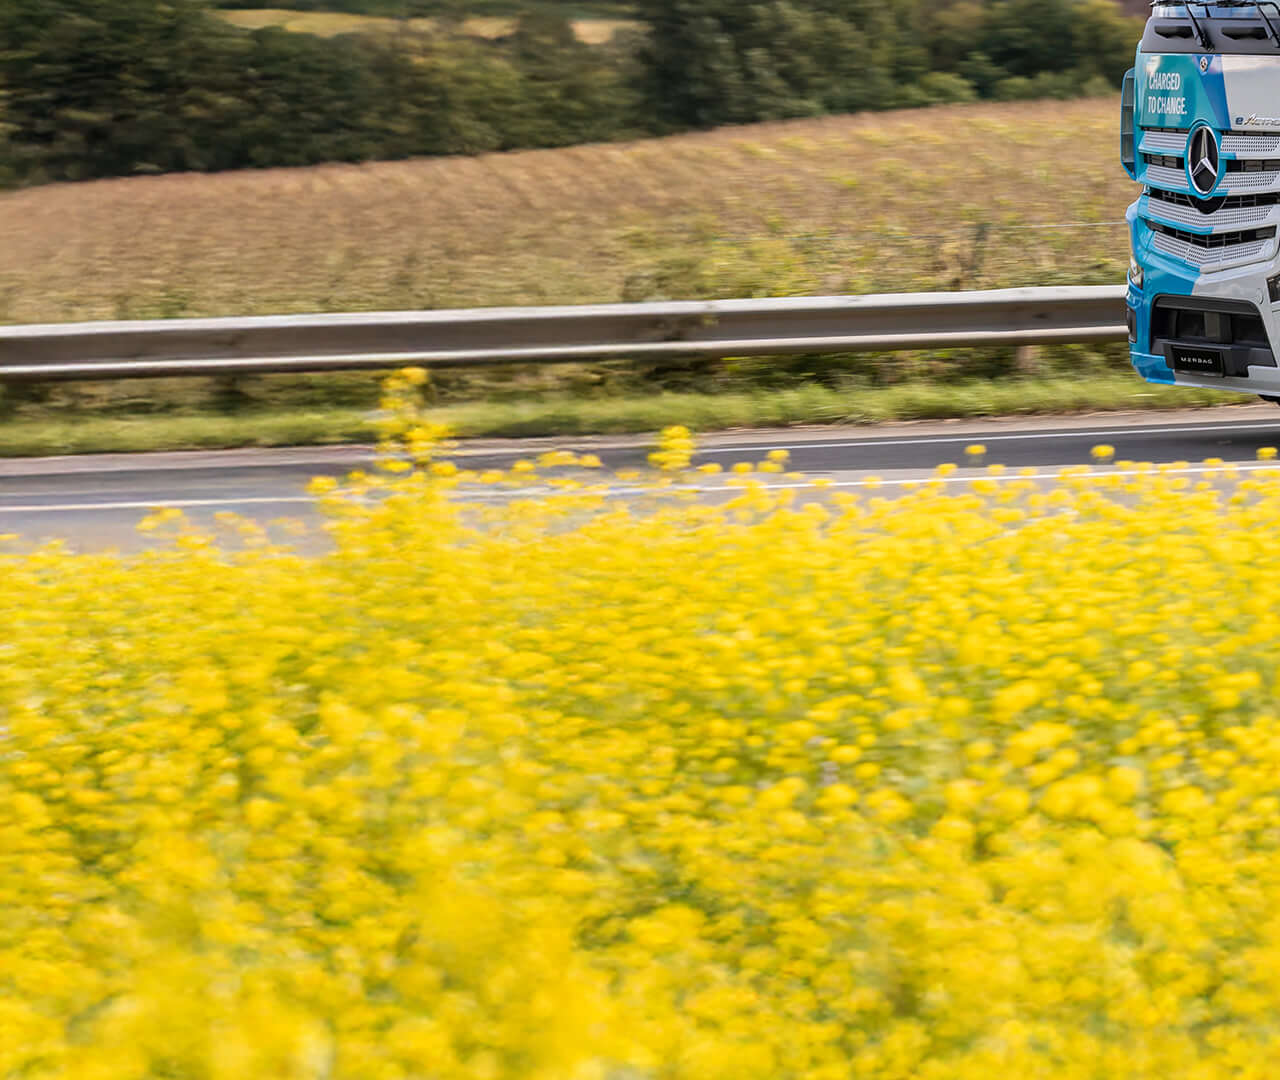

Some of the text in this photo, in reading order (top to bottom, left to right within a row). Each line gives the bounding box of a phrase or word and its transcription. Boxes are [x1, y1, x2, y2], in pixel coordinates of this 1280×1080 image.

[1148, 72, 1181, 90] CHARGED
[1148, 96, 1188, 114] TO CHANGE.
[1180, 356, 1213, 364] MERBAG
